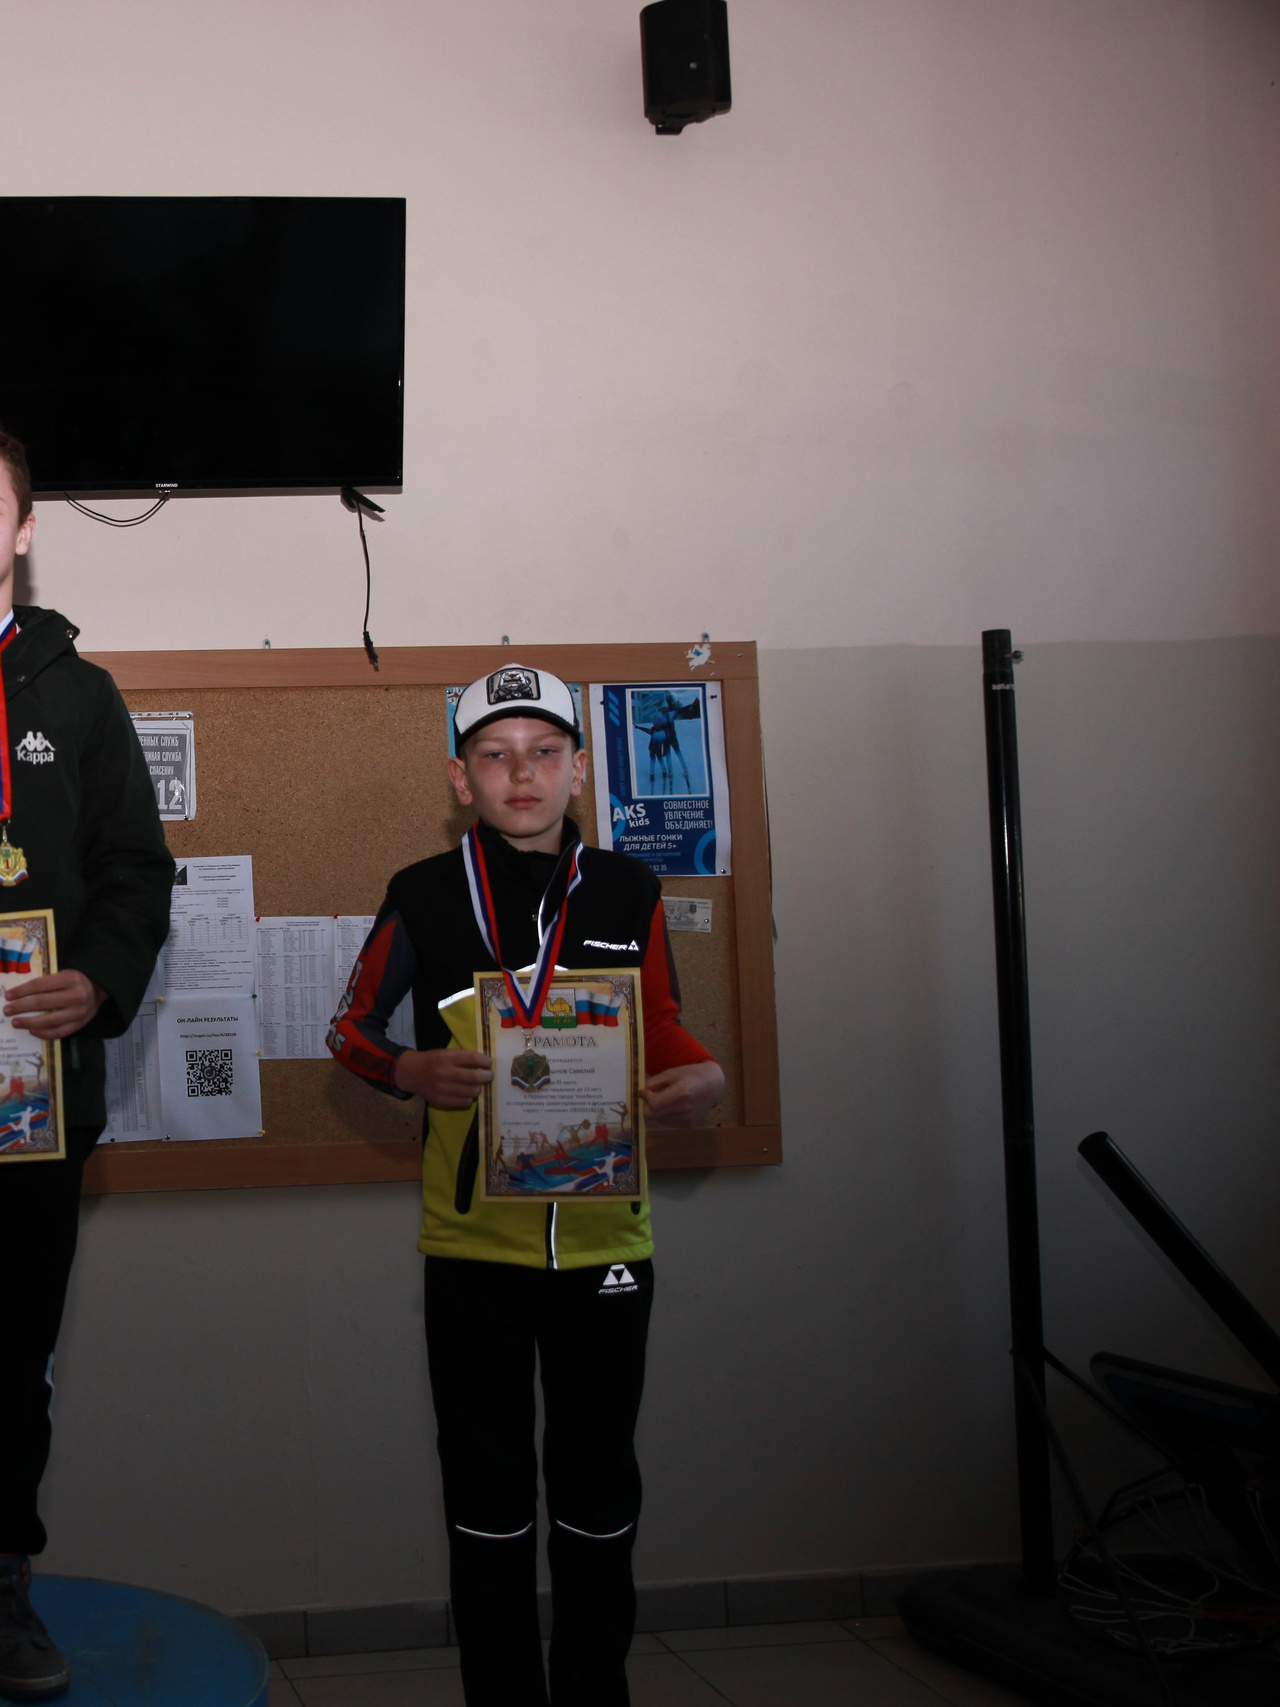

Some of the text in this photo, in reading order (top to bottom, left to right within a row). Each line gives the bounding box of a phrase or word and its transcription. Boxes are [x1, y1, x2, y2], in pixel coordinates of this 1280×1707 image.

[160, 735, 179, 747] СЛУЖБ
[16, 749, 55, 765] Kappa
[143, 751, 182, 763] ДИНАЯ СЛУЖБА
[149, 765, 174, 776] СПАСЕНИЯ
[157, 779, 182, 810] 12
[663, 799, 710, 810] СОВМЕСТНОЕ
[612, 803, 647, 822] AKS
[663, 810, 704, 820] УВЛЕЧЕНИЕ
[628, 817, 650, 828] kids
[664, 820, 714, 831] ОБЪЕДИНЯЕТ!
[619, 835, 655, 843] ЛЫЖНЫЕ
[623, 844, 640, 852] ДЛЯ
[640, 842, 667, 851] ДЕТЕЙ
[583, 940, 628, 951] FISCHER
[524, 1036, 597, 1047] ГРАМОТА
[598, 1284, 639, 1294] FISCHER
